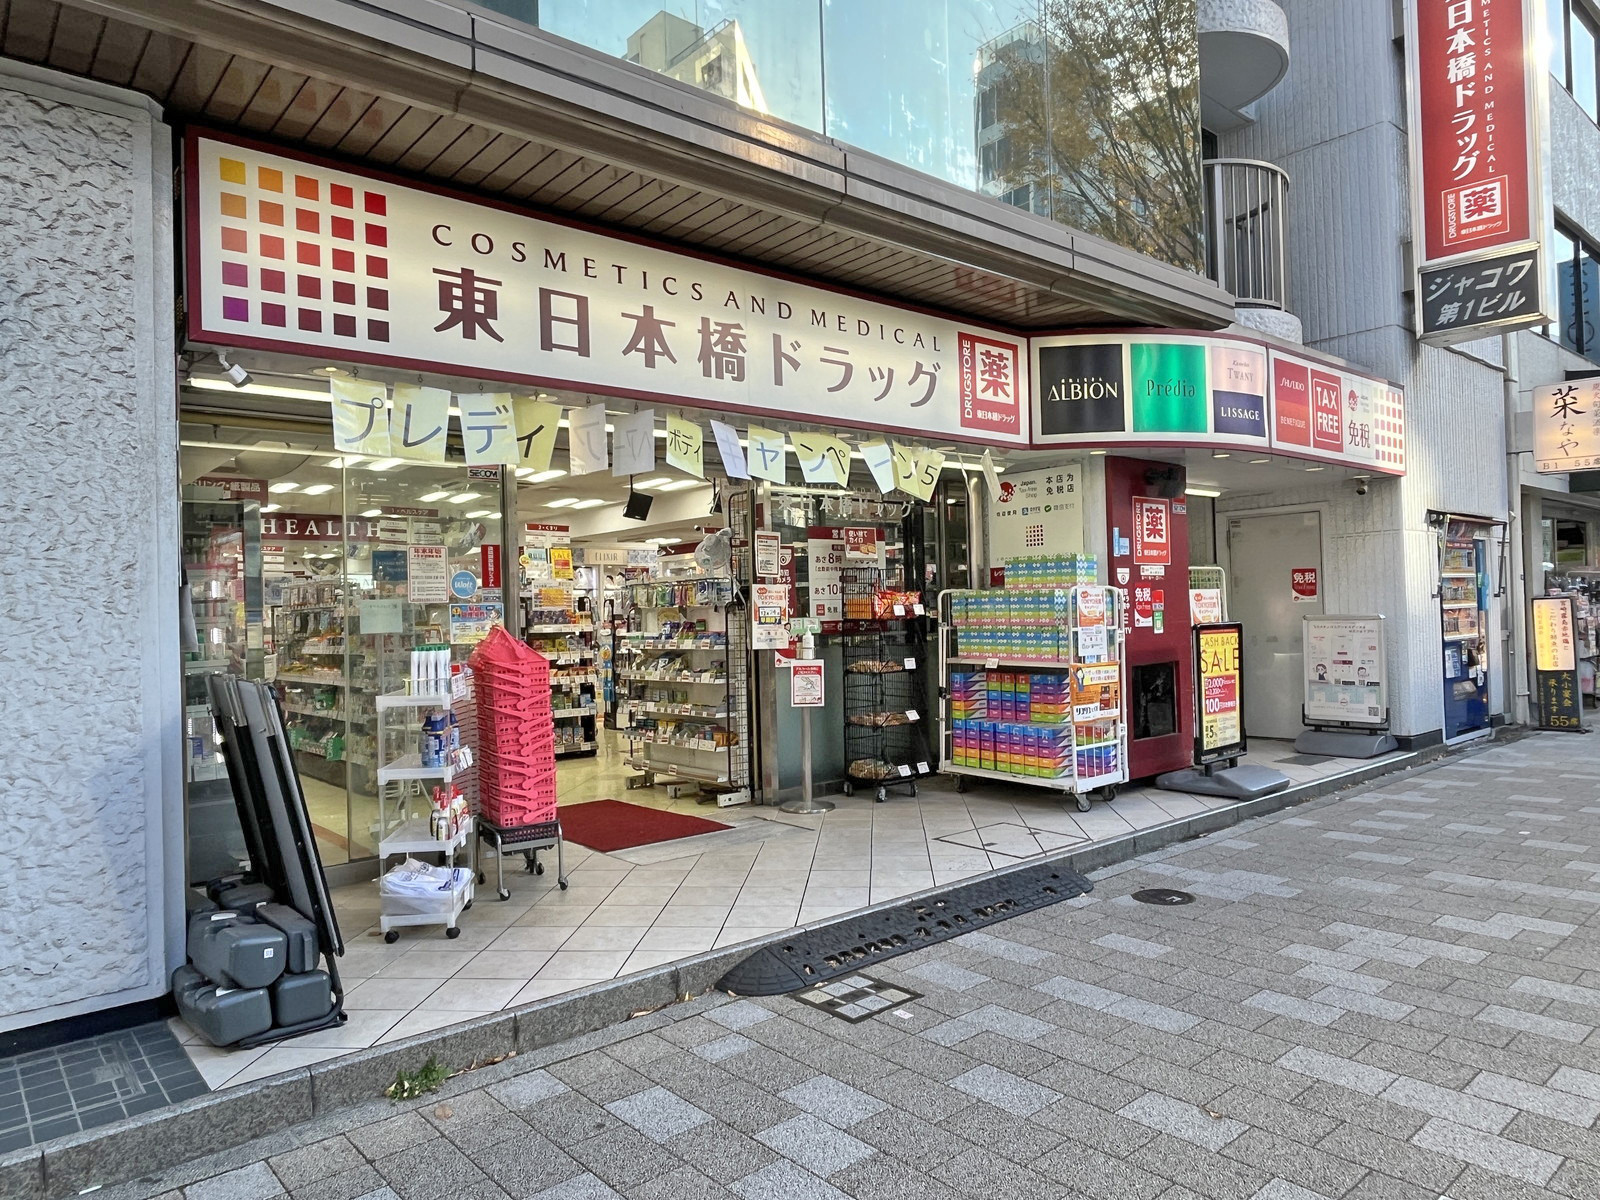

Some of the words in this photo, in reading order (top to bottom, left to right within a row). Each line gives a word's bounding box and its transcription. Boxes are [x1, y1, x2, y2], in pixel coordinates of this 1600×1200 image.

[1446, 0, 1480, 181] 日本橋ドラッグ
[1484, 63, 1494, 94] AND
[1485, 101, 1496, 173] MEDICAL
[1448, 193, 1457, 238] DRUGSTORE
[1463, 187, 1497, 219] 薬
[431, 223, 704, 301] COSMETICS
[724, 290, 793, 320] AND
[810, 310, 941, 352] MEDICAL
[1426, 258, 1534, 302] ジャコワ
[1436, 290, 1526, 326] 第1ビル
[431, 266, 942, 409] 東日本橋ドラッグ
[962, 339, 974, 418] DRUGSTORE
[980, 350, 1010, 398] 薬
[1146, 378, 1196, 398] Prédia
[1227, 367, 1254, 384] TWANY
[1220, 406, 1261, 421] LISSAGE
[1316, 386, 1338, 410] TAX
[1317, 411, 1339, 435] FREE
[1348, 419, 1371, 449] 免税
[469, 469, 498, 478] SECOM
[261, 518, 380, 537] HEALTH
[1145, 506, 1164, 539] 薬
[1200, 648, 1239, 674] SALE
